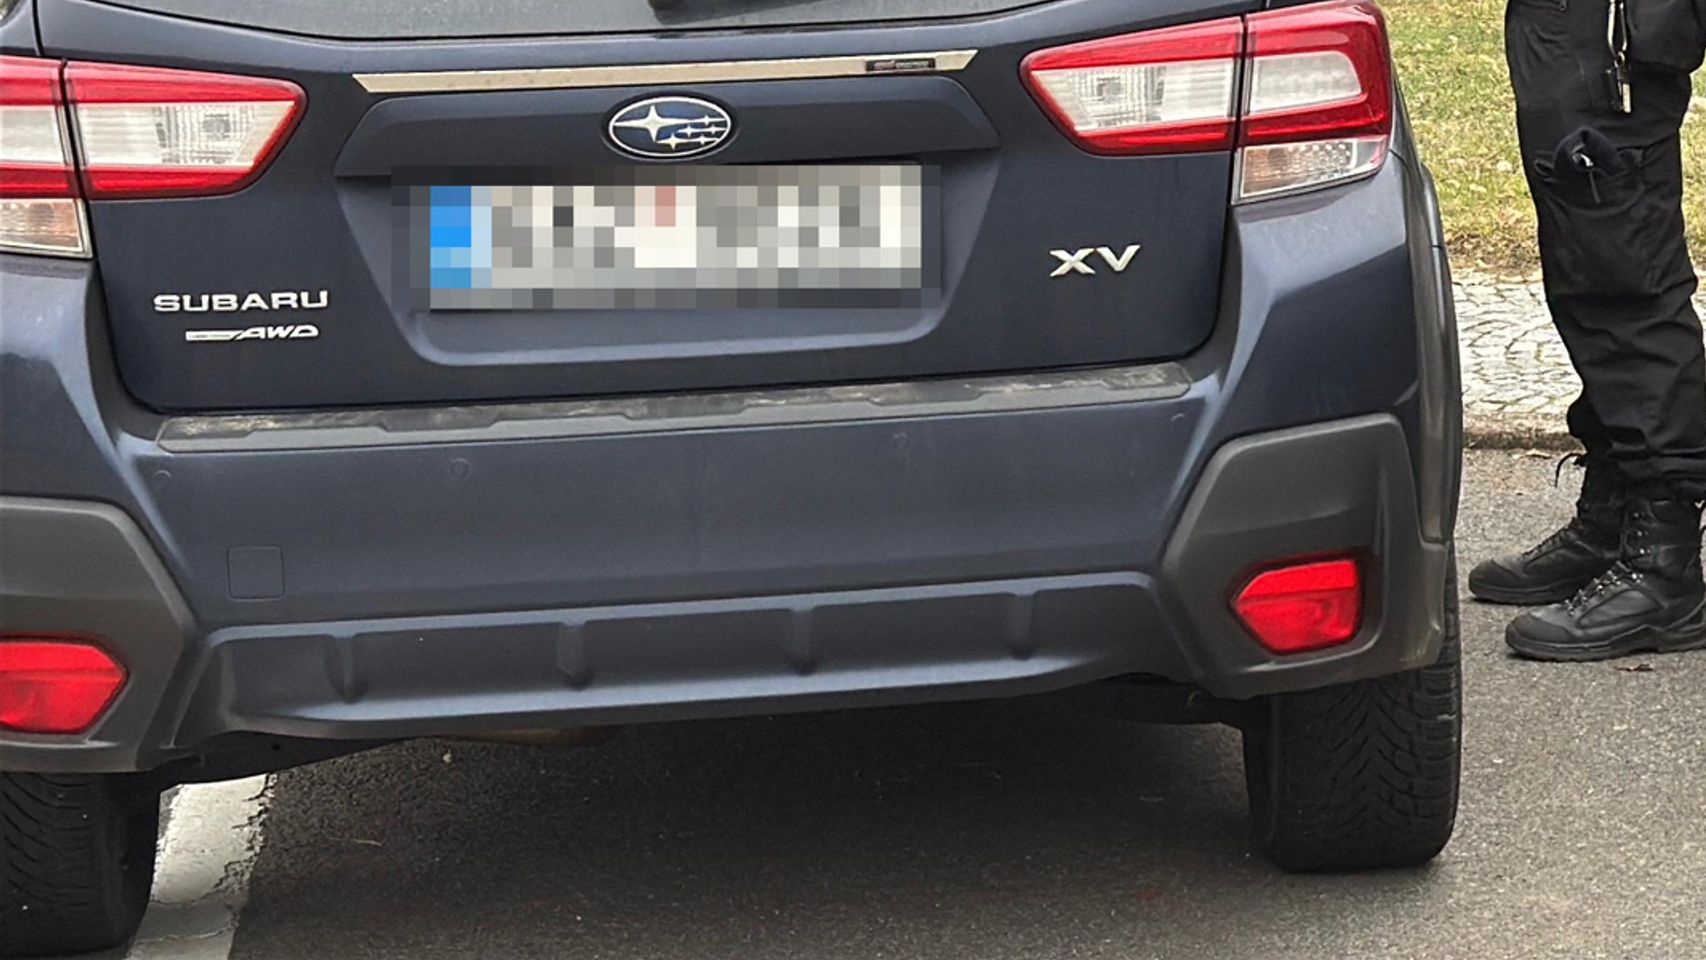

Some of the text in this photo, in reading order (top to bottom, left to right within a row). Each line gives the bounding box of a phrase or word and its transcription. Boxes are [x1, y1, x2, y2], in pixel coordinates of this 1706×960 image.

[1048, 244, 1141, 277] XV
[153, 290, 328, 312] SUBARU
[234, 324, 320, 341] AWD
